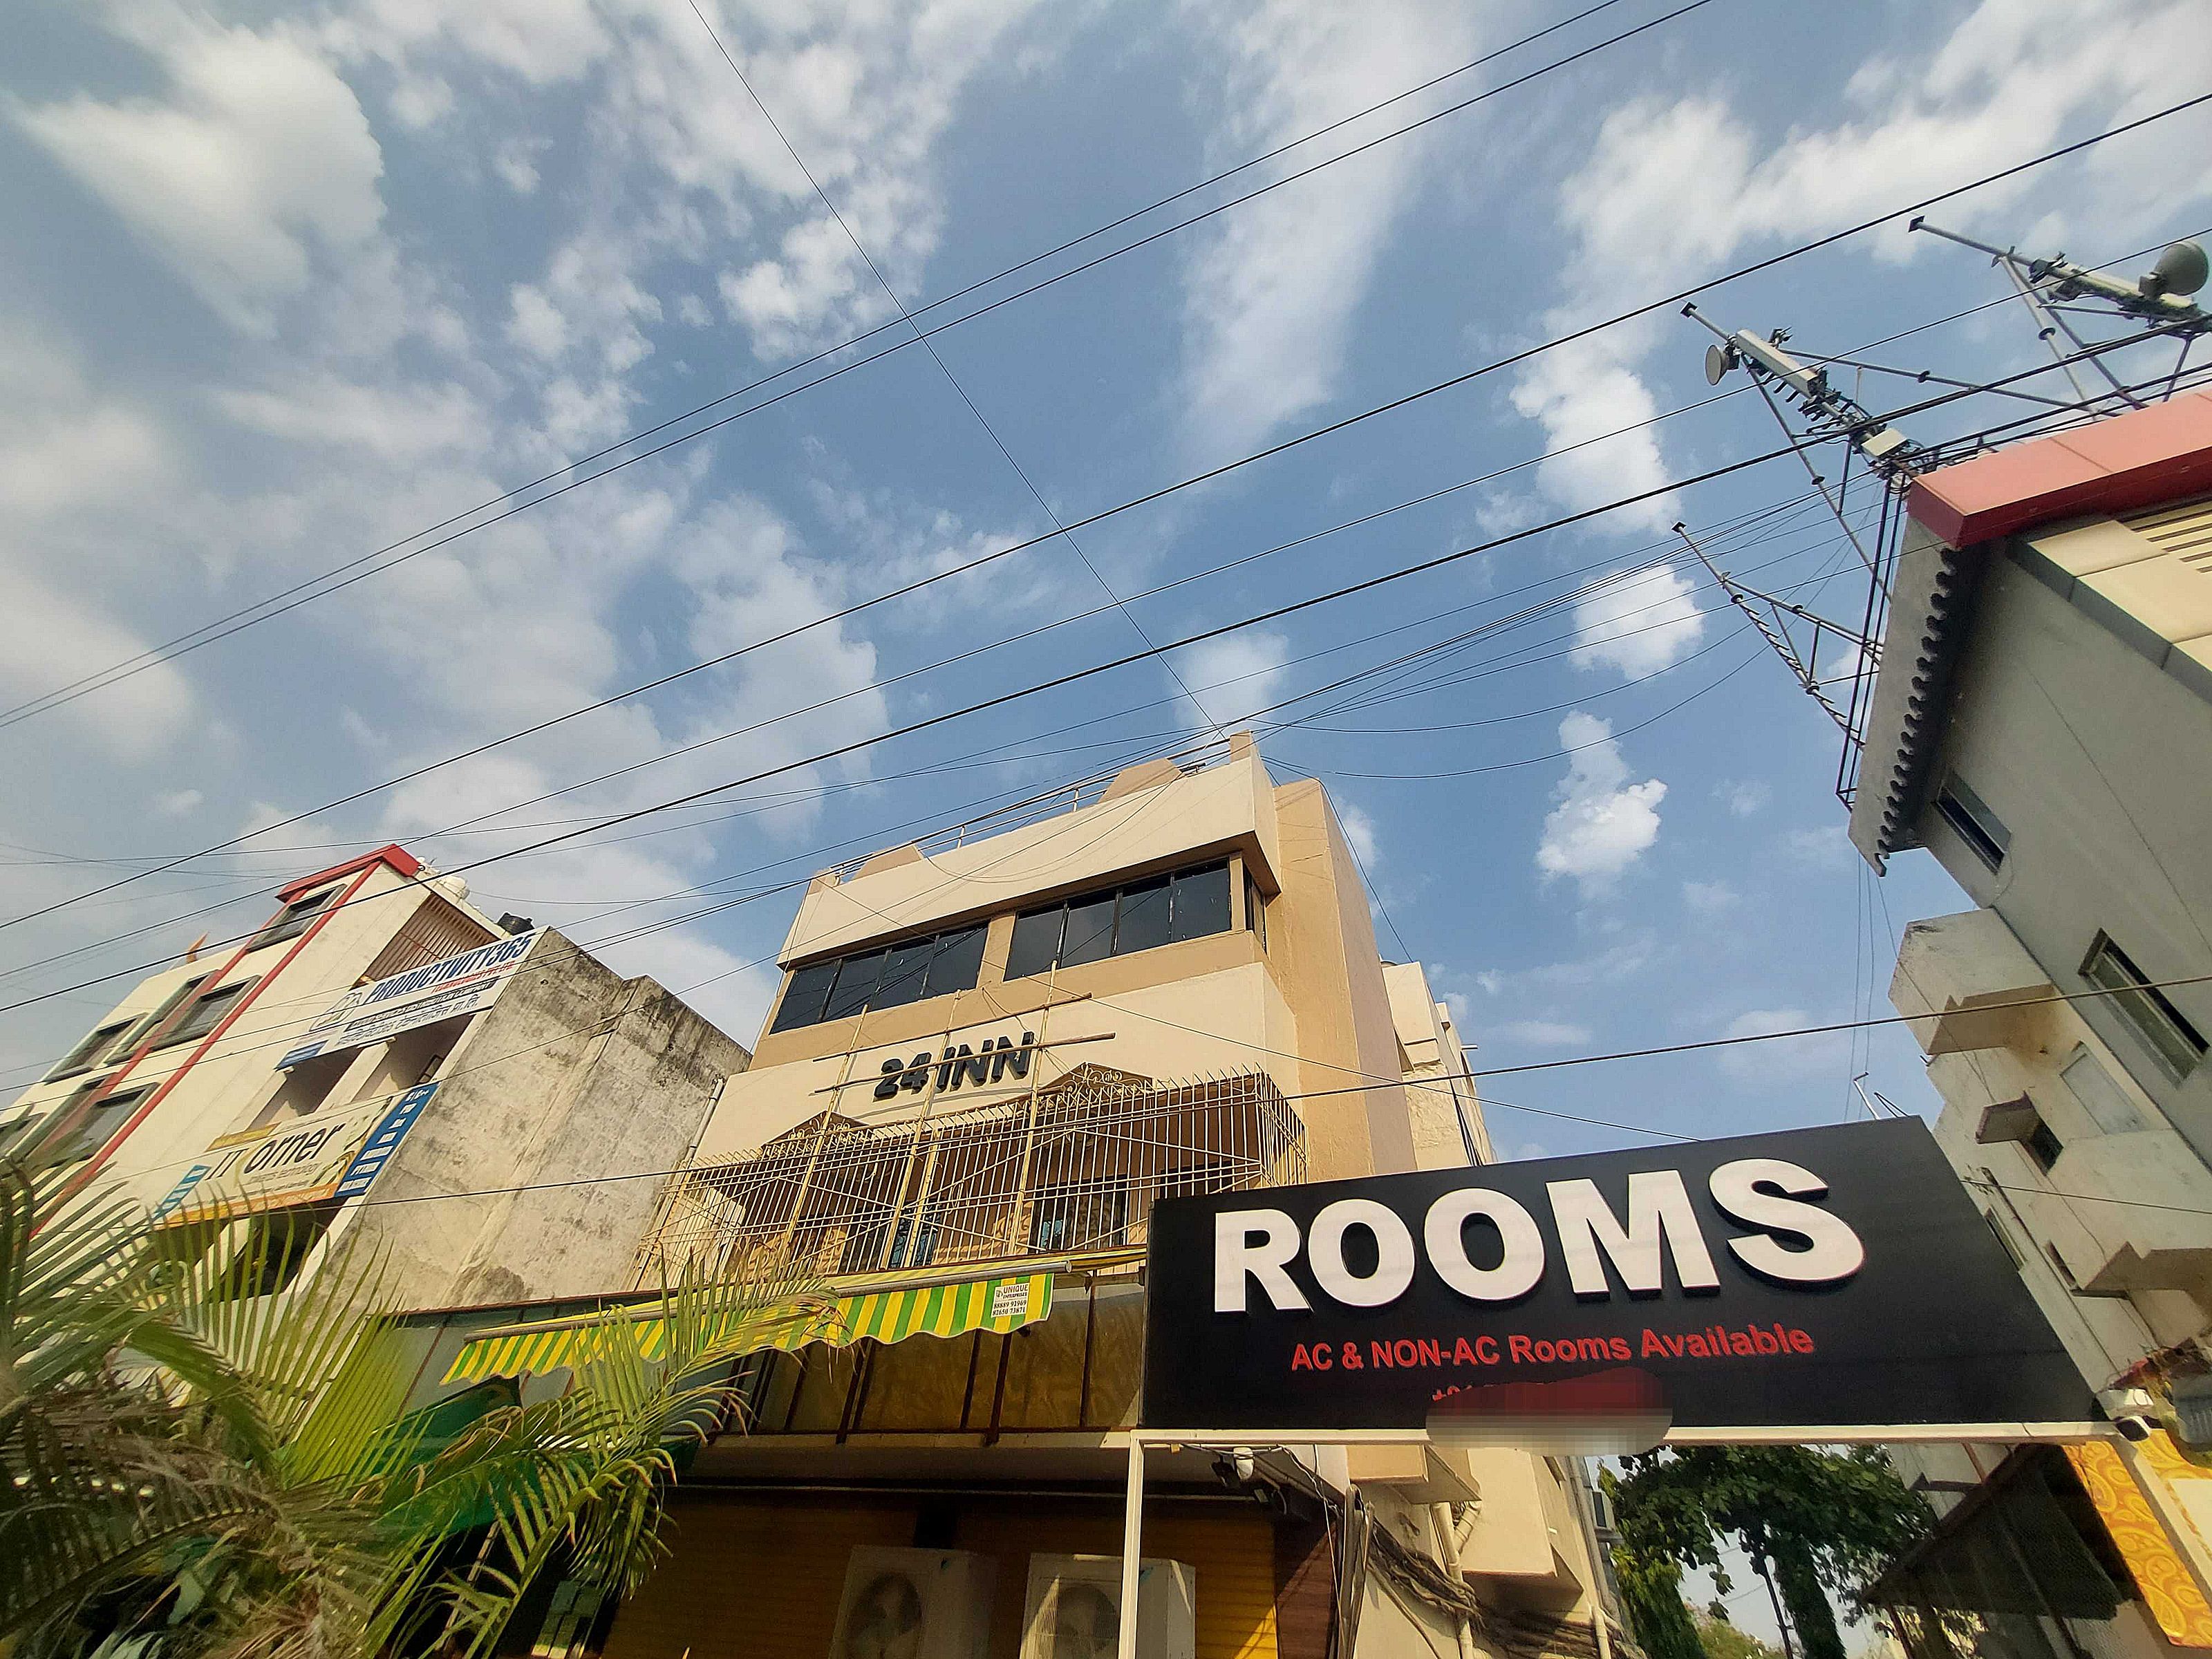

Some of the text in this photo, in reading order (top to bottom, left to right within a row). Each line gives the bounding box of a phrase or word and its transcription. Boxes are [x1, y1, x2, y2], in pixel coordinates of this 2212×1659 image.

[364, 932, 536, 1004] PRODUCTIVITY365
[873, 1031, 1035, 1102] 24 INN
[1214, 1157, 1866, 1313] ROOMS
[1004, 1284, 1029, 1293] UNIQUE
[1291, 1322, 1815, 1371] AC & NON-AC Rooms Available
